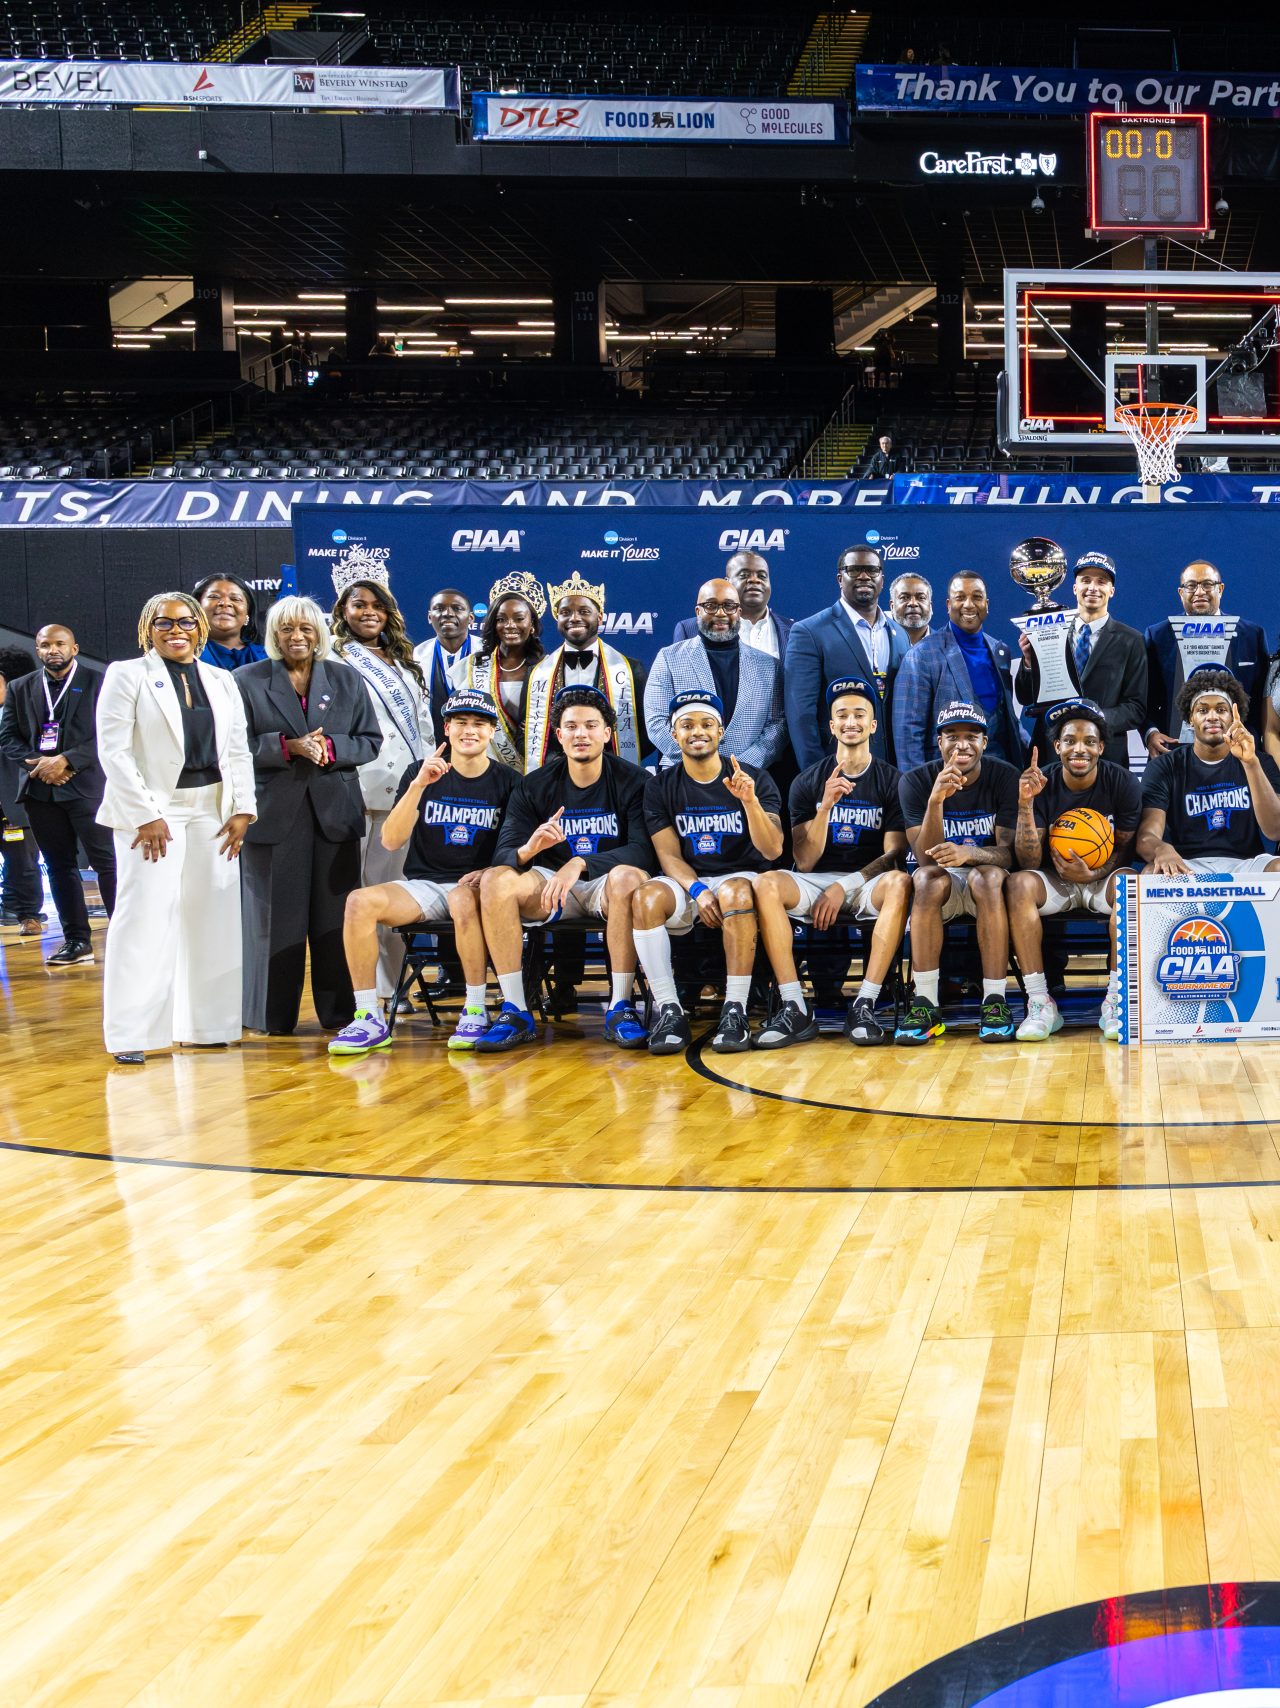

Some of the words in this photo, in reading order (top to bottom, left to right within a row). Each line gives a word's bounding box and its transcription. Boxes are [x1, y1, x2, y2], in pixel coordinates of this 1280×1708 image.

[13, 70, 113, 92] BEVEL
[319, 79, 356, 87] BEVERLY
[358, 79, 408, 89] WINSTEAD
[894, 73, 1001, 102] Thank
[1012, 75, 1078, 104] You
[1088, 76, 1125, 105] to
[1135, 78, 1200, 106] Our
[499, 107, 581, 129] DTLR
[605, 111, 649, 128] FOOD
[677, 113, 715, 129] LION
[761, 108, 790, 120] GOOD
[919, 152, 1011, 175] CareFirst
[196, 288, 219, 301] 109
[575, 291, 595, 302] 110
[941, 294, 960, 305] 112
[1019, 419, 1055, 431] CIAA
[1018, 434, 1048, 442] SPALDING
[0, 491, 112, 527] TS,
[451, 529, 521, 552] CIAA
[718, 528, 786, 552] CIAA
[308, 549, 337, 557] MAKE
[338, 549, 349, 557] IT
[581, 550, 608, 558] MAKE
[610, 550, 620, 558] IT
[621, 544, 660, 562] YOURS
[882, 543, 920, 560] YOURS
[244, 579, 282, 591] NTRY
[1026, 612, 1066, 631] CIAA
[1182, 622, 1225, 639] CIAA
[833, 678, 865, 691] CIAA
[359, 654, 396, 689] Fayetteville
[389, 688, 405, 707] State
[400, 705, 418, 741] University
[677, 694, 712, 702] CIAA
[620, 741, 636, 749] 2026
[1185, 786, 1250, 816] CHAMPIONS
[424, 800, 501, 831] CHAMPIONS
[557, 812, 619, 838] HAMPIONS
[1146, 887, 1184, 898] MEN'S
[1186, 886, 1266, 898] BASKETBALL
[1170, 946, 1194, 955] FOOD
[1207, 946, 1228, 955] LION
[1159, 955, 1235, 982] CIAA
[1166, 982, 1233, 991] TOURNAMENT
